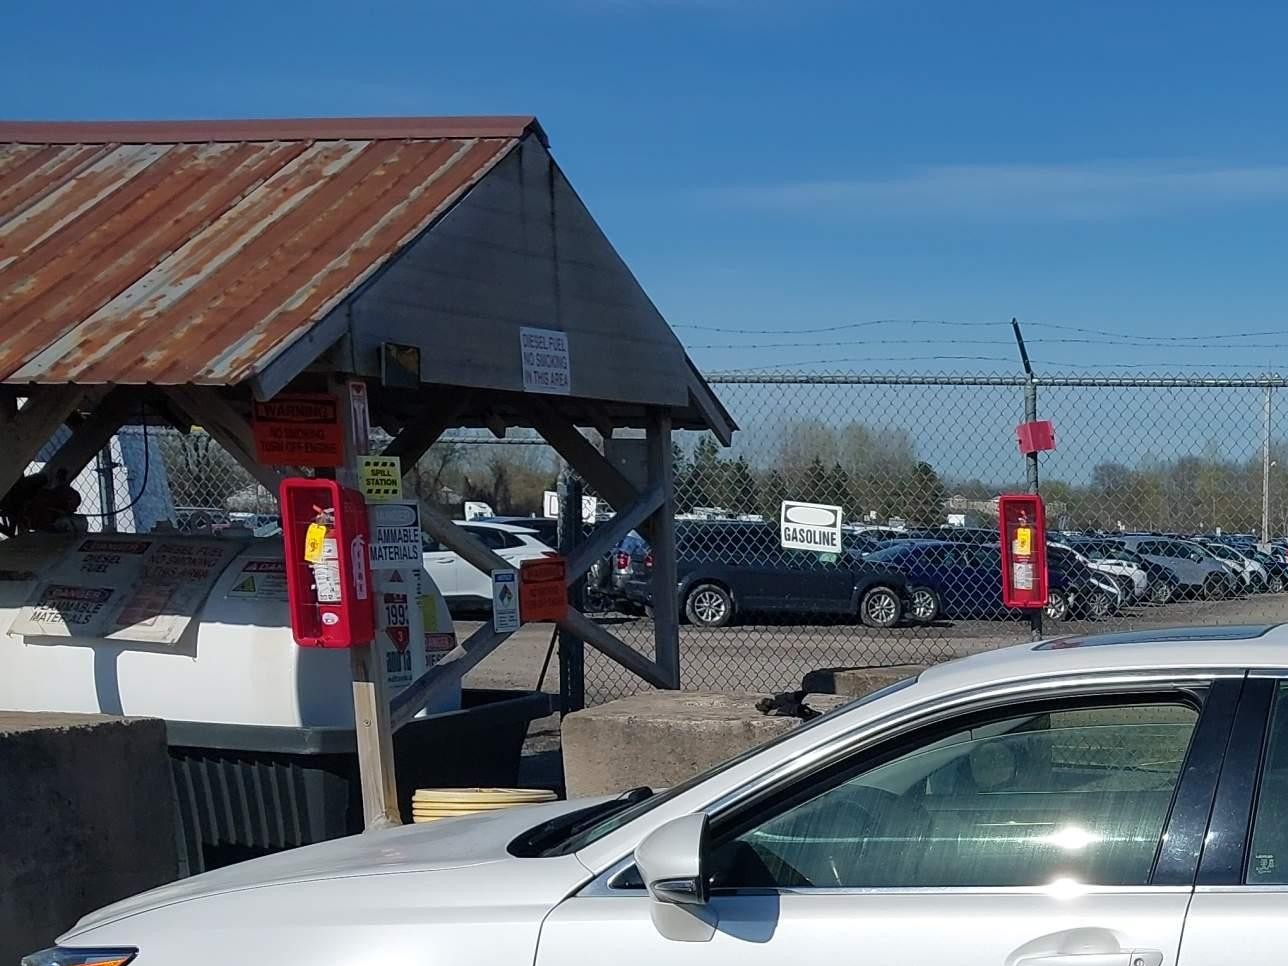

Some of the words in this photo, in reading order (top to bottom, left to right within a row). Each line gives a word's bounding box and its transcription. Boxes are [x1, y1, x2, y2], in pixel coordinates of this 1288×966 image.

[523, 334, 548, 350] DIESEL
[549, 337, 567, 352] FUEL
[524, 351, 535, 366] NO
[536, 353, 568, 369] SMOKING
[533, 371, 550, 385] THIS
[551, 372, 568, 386] AREA
[371, 469, 392, 477] SPILL
[366, 478, 398, 487] STATION
[377, 528, 419, 544] AMMABLE
[784, 527, 837, 547] GASOLINE
[370, 545, 418, 561] MATERIALS
[35, 600, 103, 614] FLAMMABLE
[29, 611, 92, 625] MATERIALS
